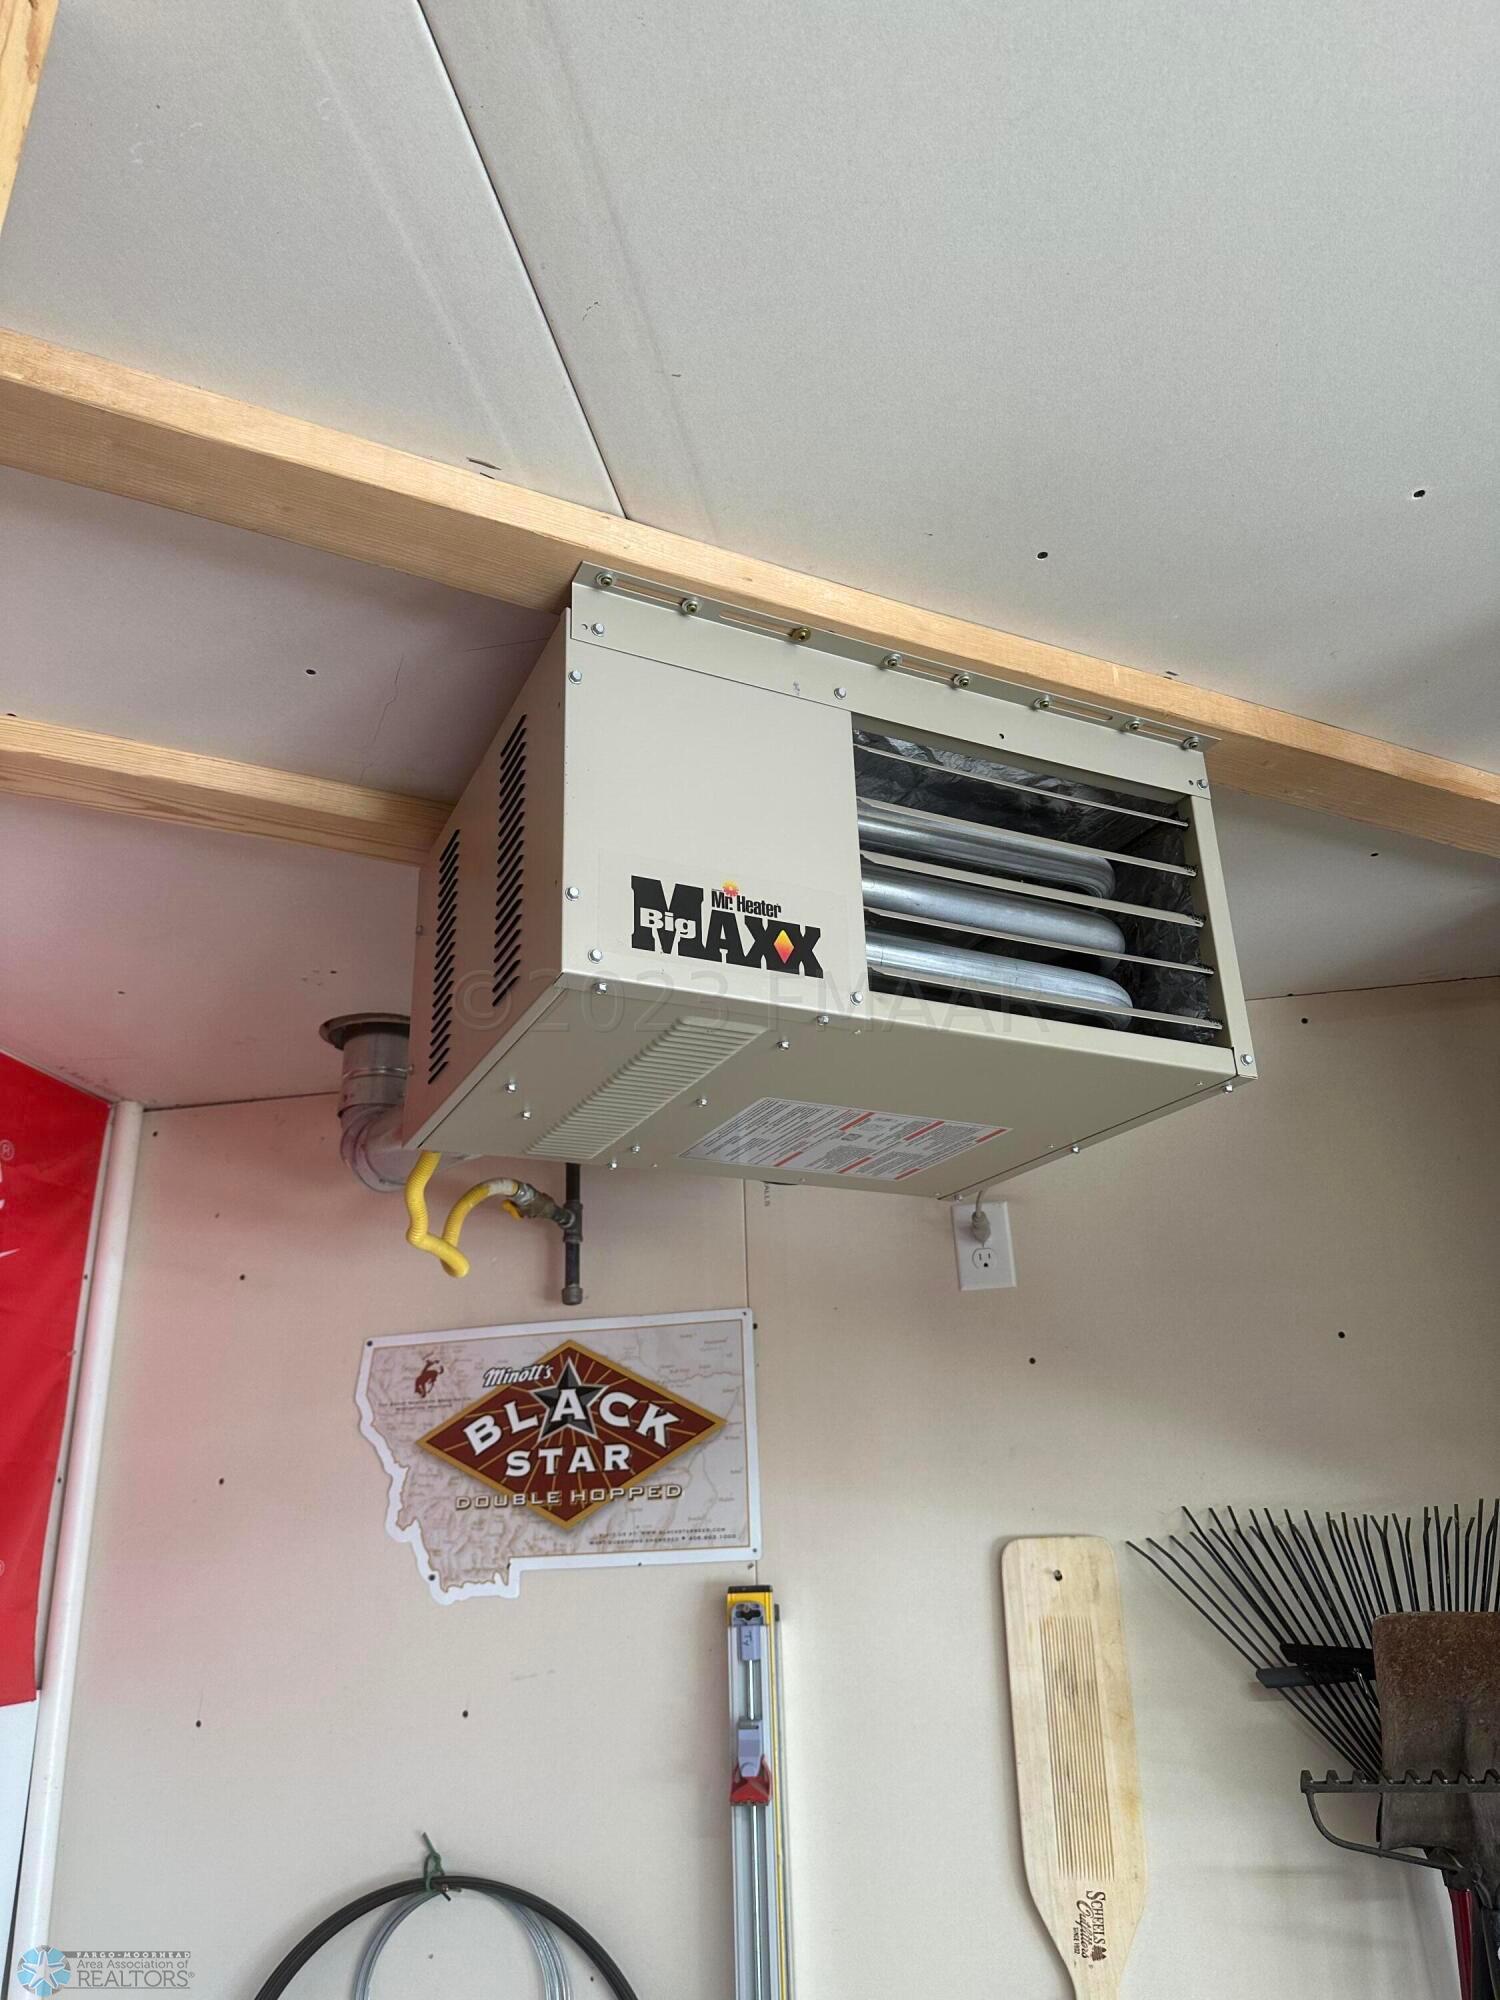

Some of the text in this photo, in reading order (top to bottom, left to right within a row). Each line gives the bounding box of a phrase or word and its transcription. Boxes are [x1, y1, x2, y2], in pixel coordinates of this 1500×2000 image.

[711, 890, 782, 918] Mr. Heater
[640, 907, 697, 939] Big
[463, 1388, 681, 1457] BLACK
[505, 1444, 633, 1478] STAR
[455, 1483, 684, 1511] DOUBLE HOPPED
[1086, 1891, 1106, 1944] SCHEELS
